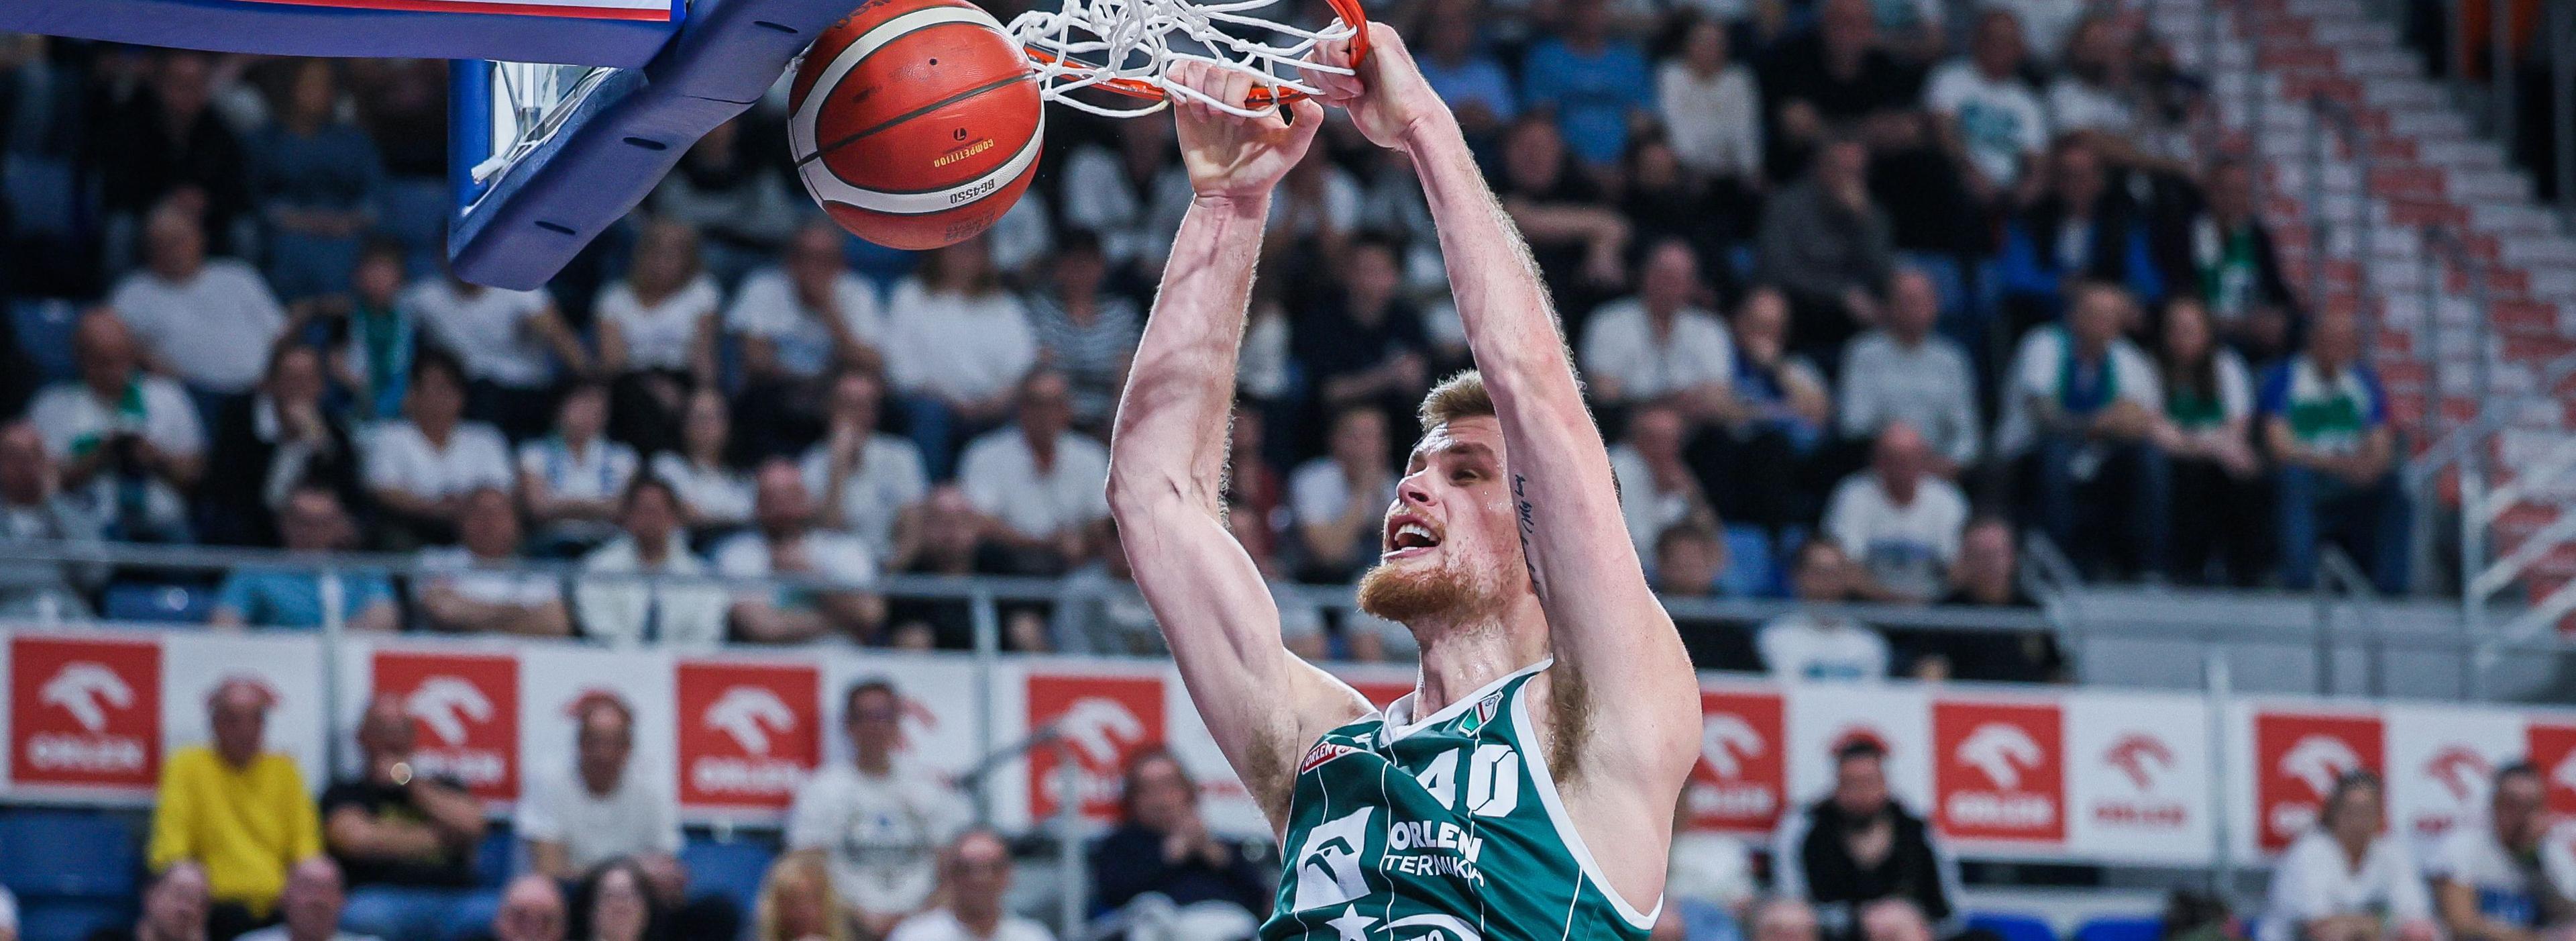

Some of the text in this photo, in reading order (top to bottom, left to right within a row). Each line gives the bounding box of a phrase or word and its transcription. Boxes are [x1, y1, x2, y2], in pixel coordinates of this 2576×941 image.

[950, 179, 995, 204] BG4550
[1305, 742, 1335, 768] ORLEN
[1415, 744, 1519, 818] 40
[1389, 820, 1483, 864] ORLEN
